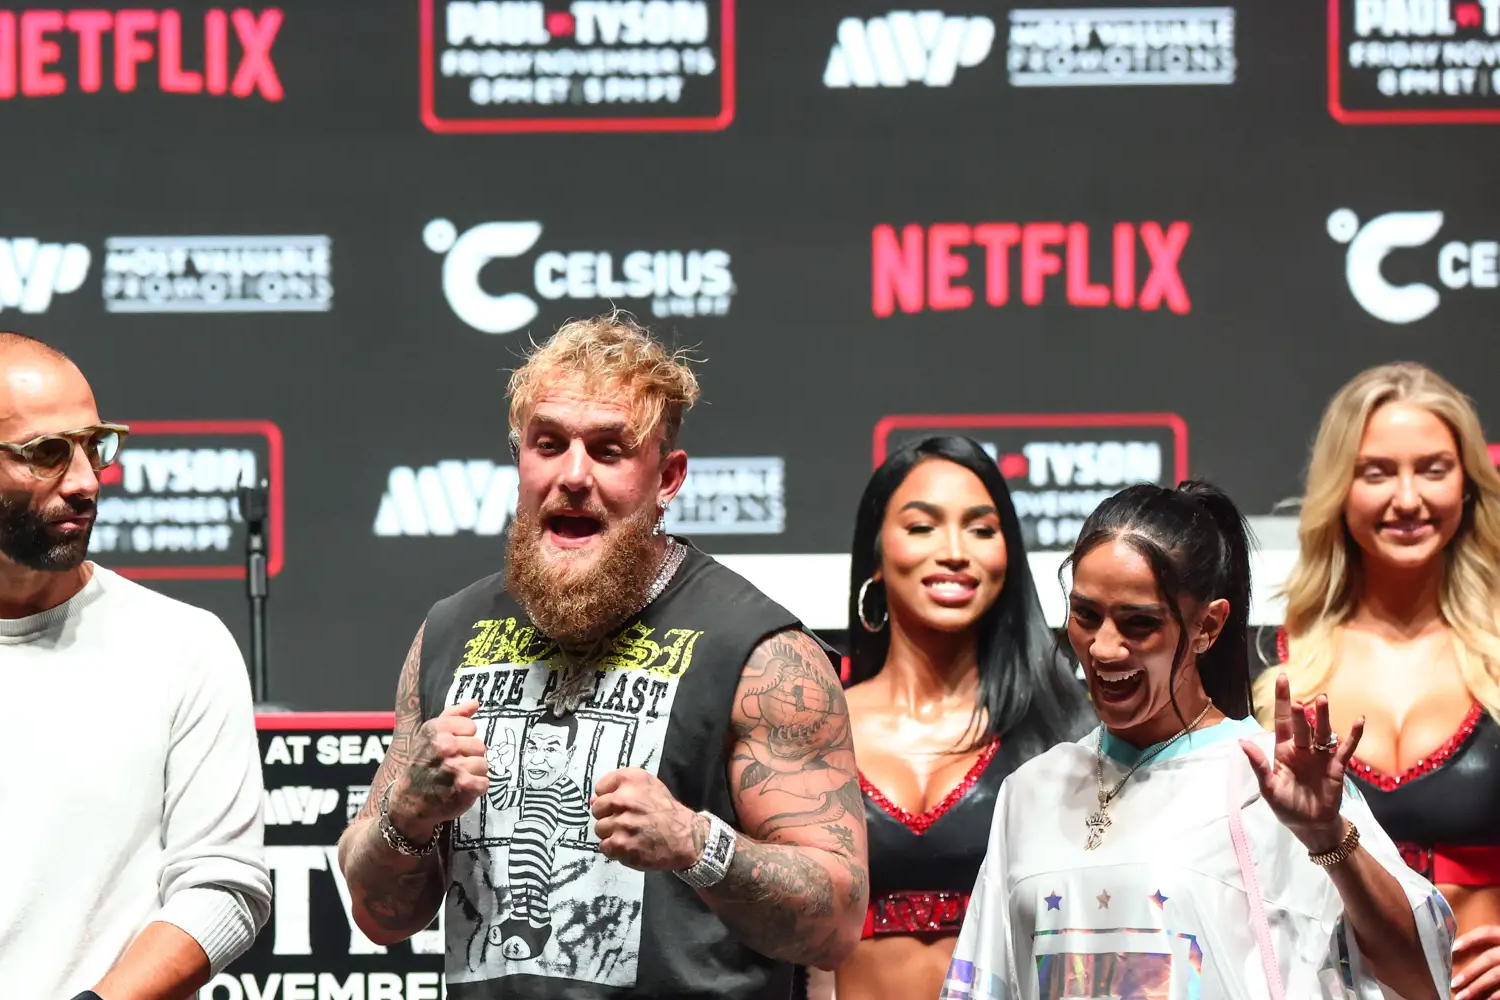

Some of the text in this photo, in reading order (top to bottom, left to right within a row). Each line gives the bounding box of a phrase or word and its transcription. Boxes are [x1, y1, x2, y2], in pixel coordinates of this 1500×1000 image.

[447, 0, 708, 45] PAUL TYSON
[824, 11, 995, 87] MVP
[534, 250, 732, 299] CELSIUS
[872, 221, 1191, 317] NETFLIX
[1023, 442, 1162, 486] TYSON
[374, 460, 519, 536] MV
[453, 668, 529, 707] FREE
[585, 670, 670, 719] LAST
[264, 735, 311, 765] AT
